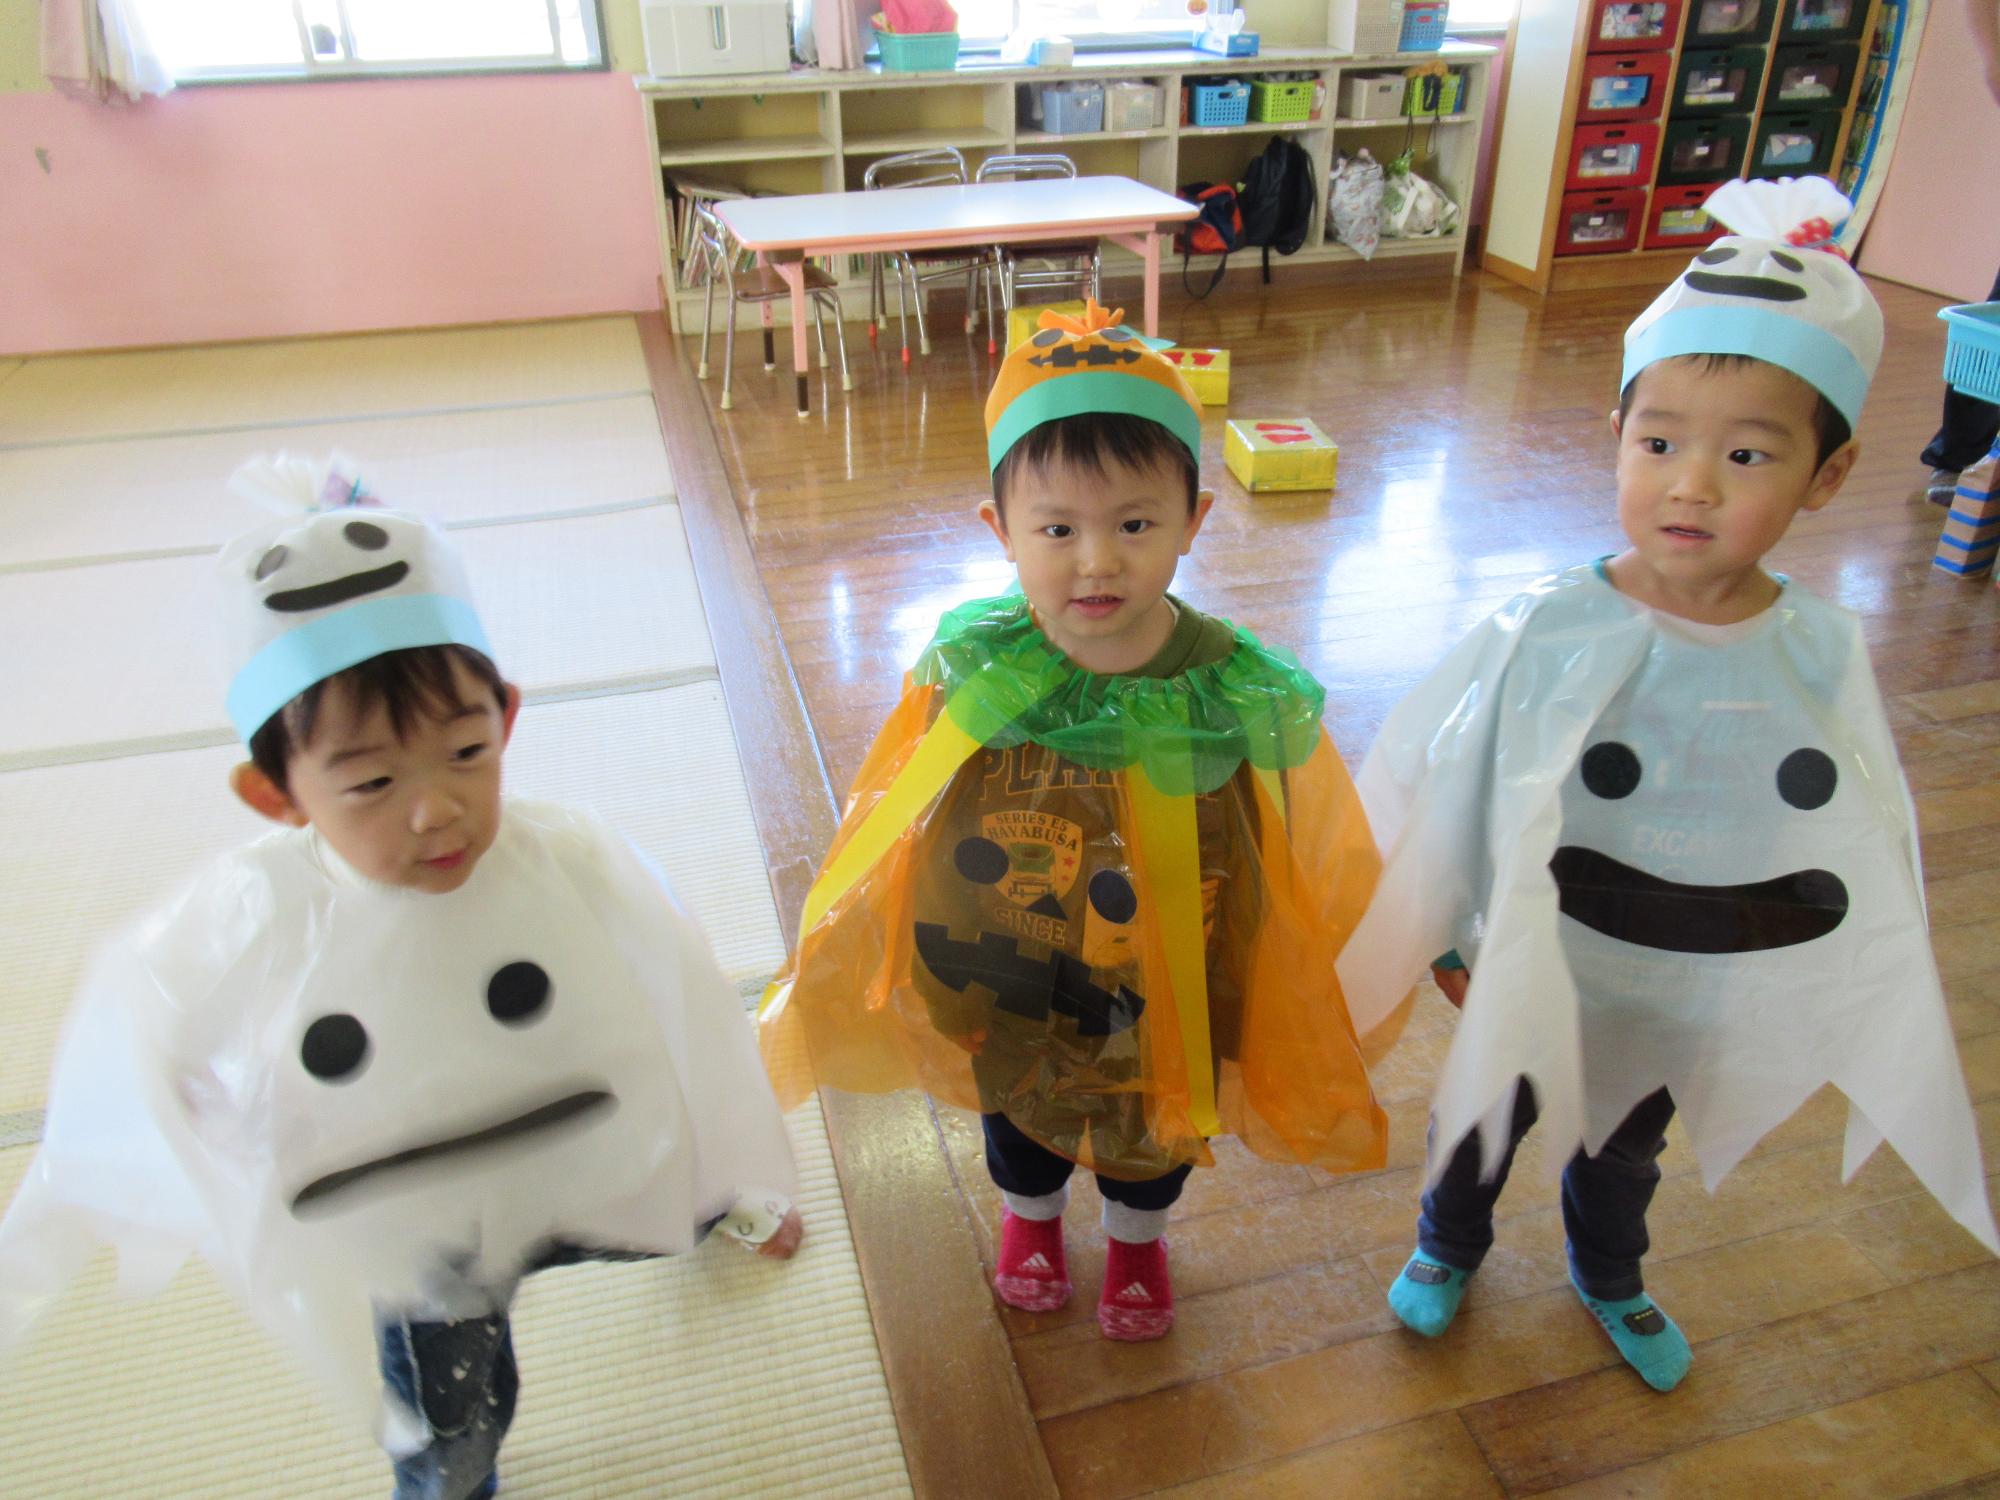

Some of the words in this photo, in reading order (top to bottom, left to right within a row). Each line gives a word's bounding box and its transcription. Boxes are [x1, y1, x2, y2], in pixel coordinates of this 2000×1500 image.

[995, 812, 1047, 826] SERIES
[1051, 816, 1070, 832] E5
[986, 825, 1077, 852] HAYABUSA
